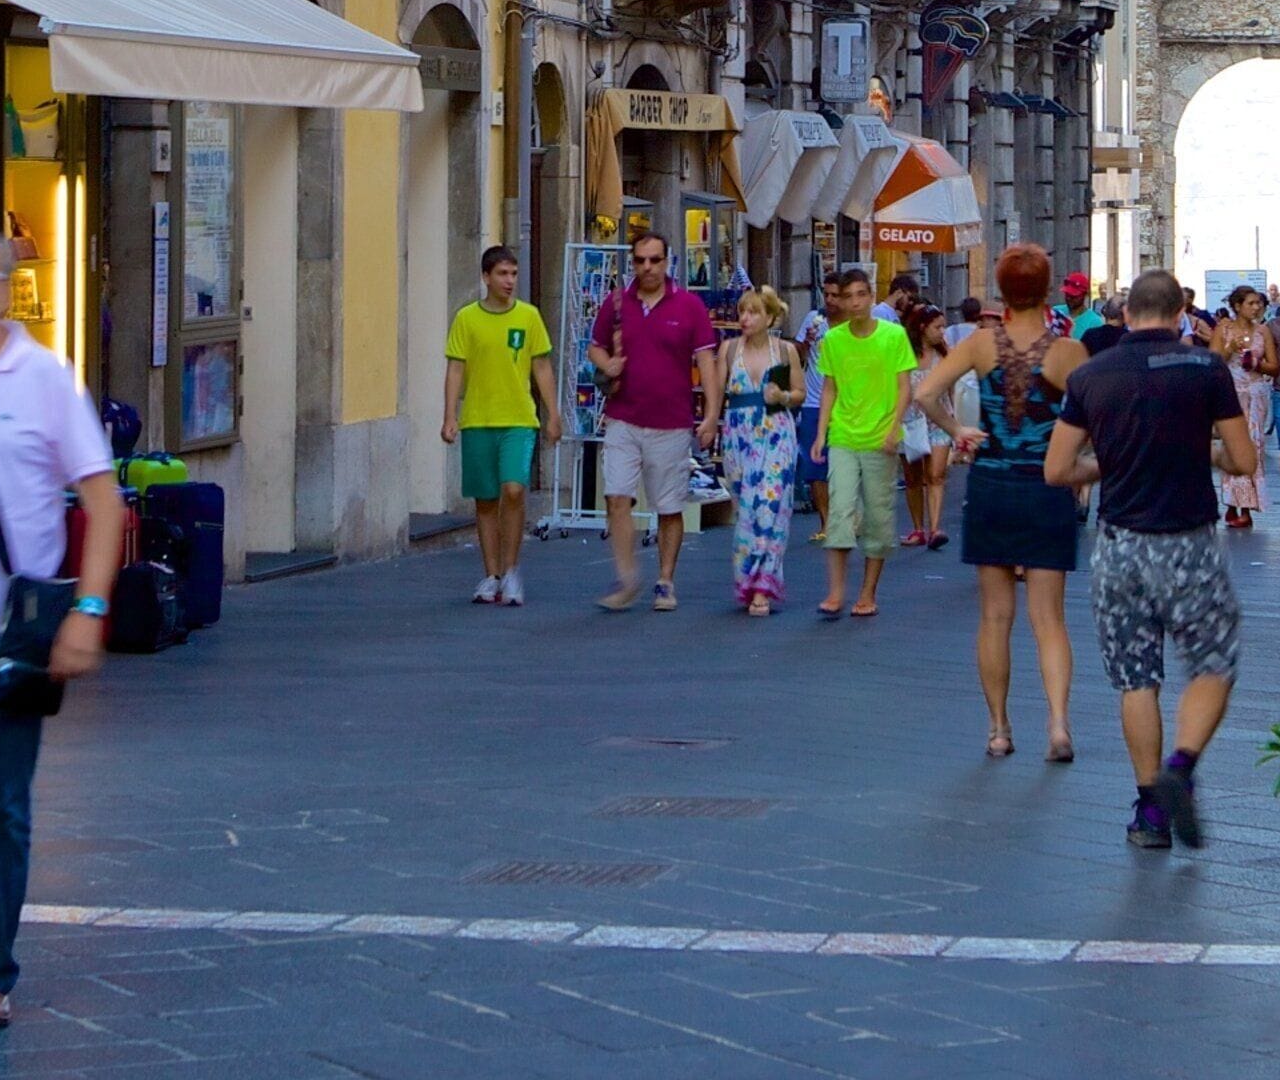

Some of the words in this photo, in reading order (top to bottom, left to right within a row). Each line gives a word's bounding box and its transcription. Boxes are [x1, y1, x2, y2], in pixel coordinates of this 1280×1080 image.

[827, 23, 863, 75] T
[630, 93, 663, 125] BARBER
[668, 96, 688, 125] SHOP
[879, 227, 935, 244] GELATO
